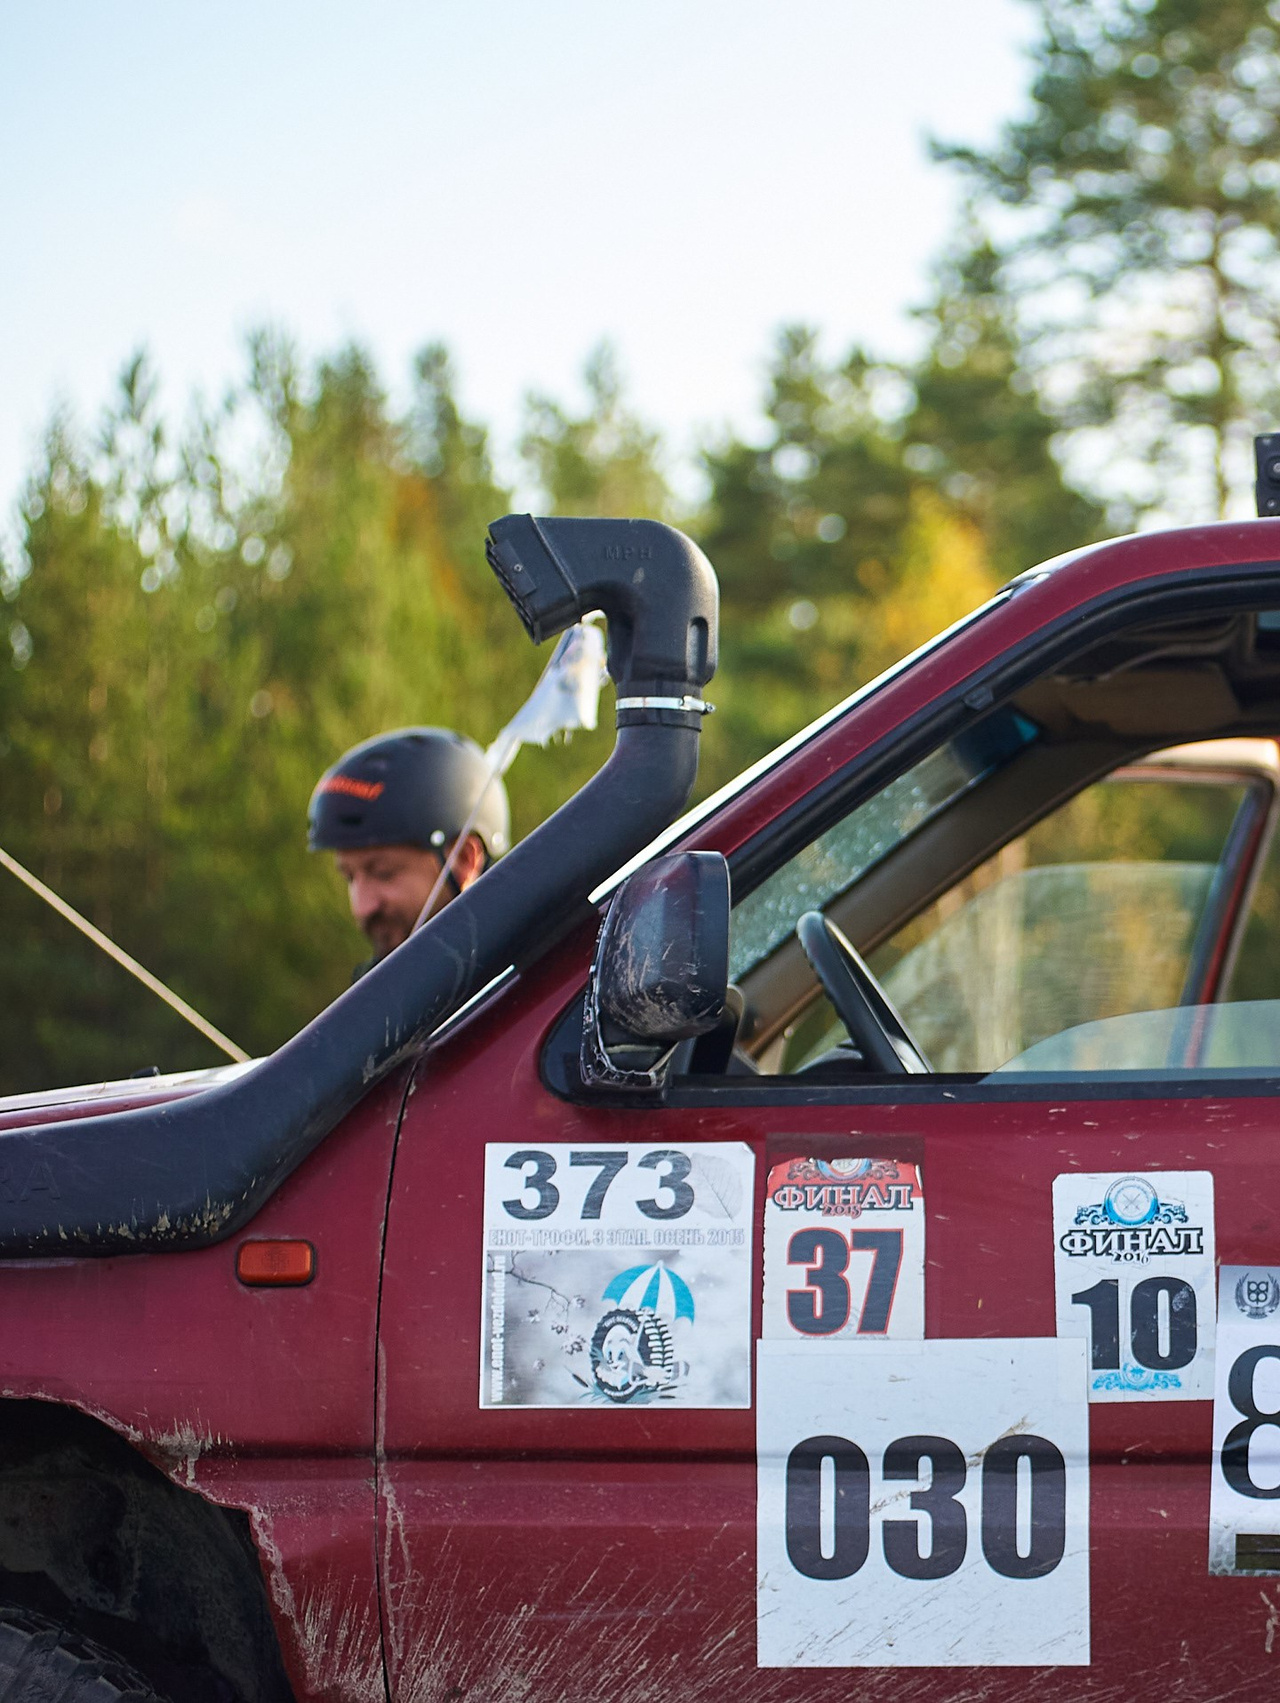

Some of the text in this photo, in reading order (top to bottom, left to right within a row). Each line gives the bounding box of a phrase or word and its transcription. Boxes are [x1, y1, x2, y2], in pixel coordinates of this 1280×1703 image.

[501, 1149, 695, 1220] 373
[773, 1183, 914, 1212] ФИНАЛ
[653, 1228, 704, 1246] ОСЕНЬ
[707, 1228, 745, 1246] 2015
[1060, 1227, 1204, 1257] ФИНАЛ
[786, 1226, 904, 1336] 37
[1071, 1276, 1198, 1371] 10
[785, 1434, 1067, 1581] 030
